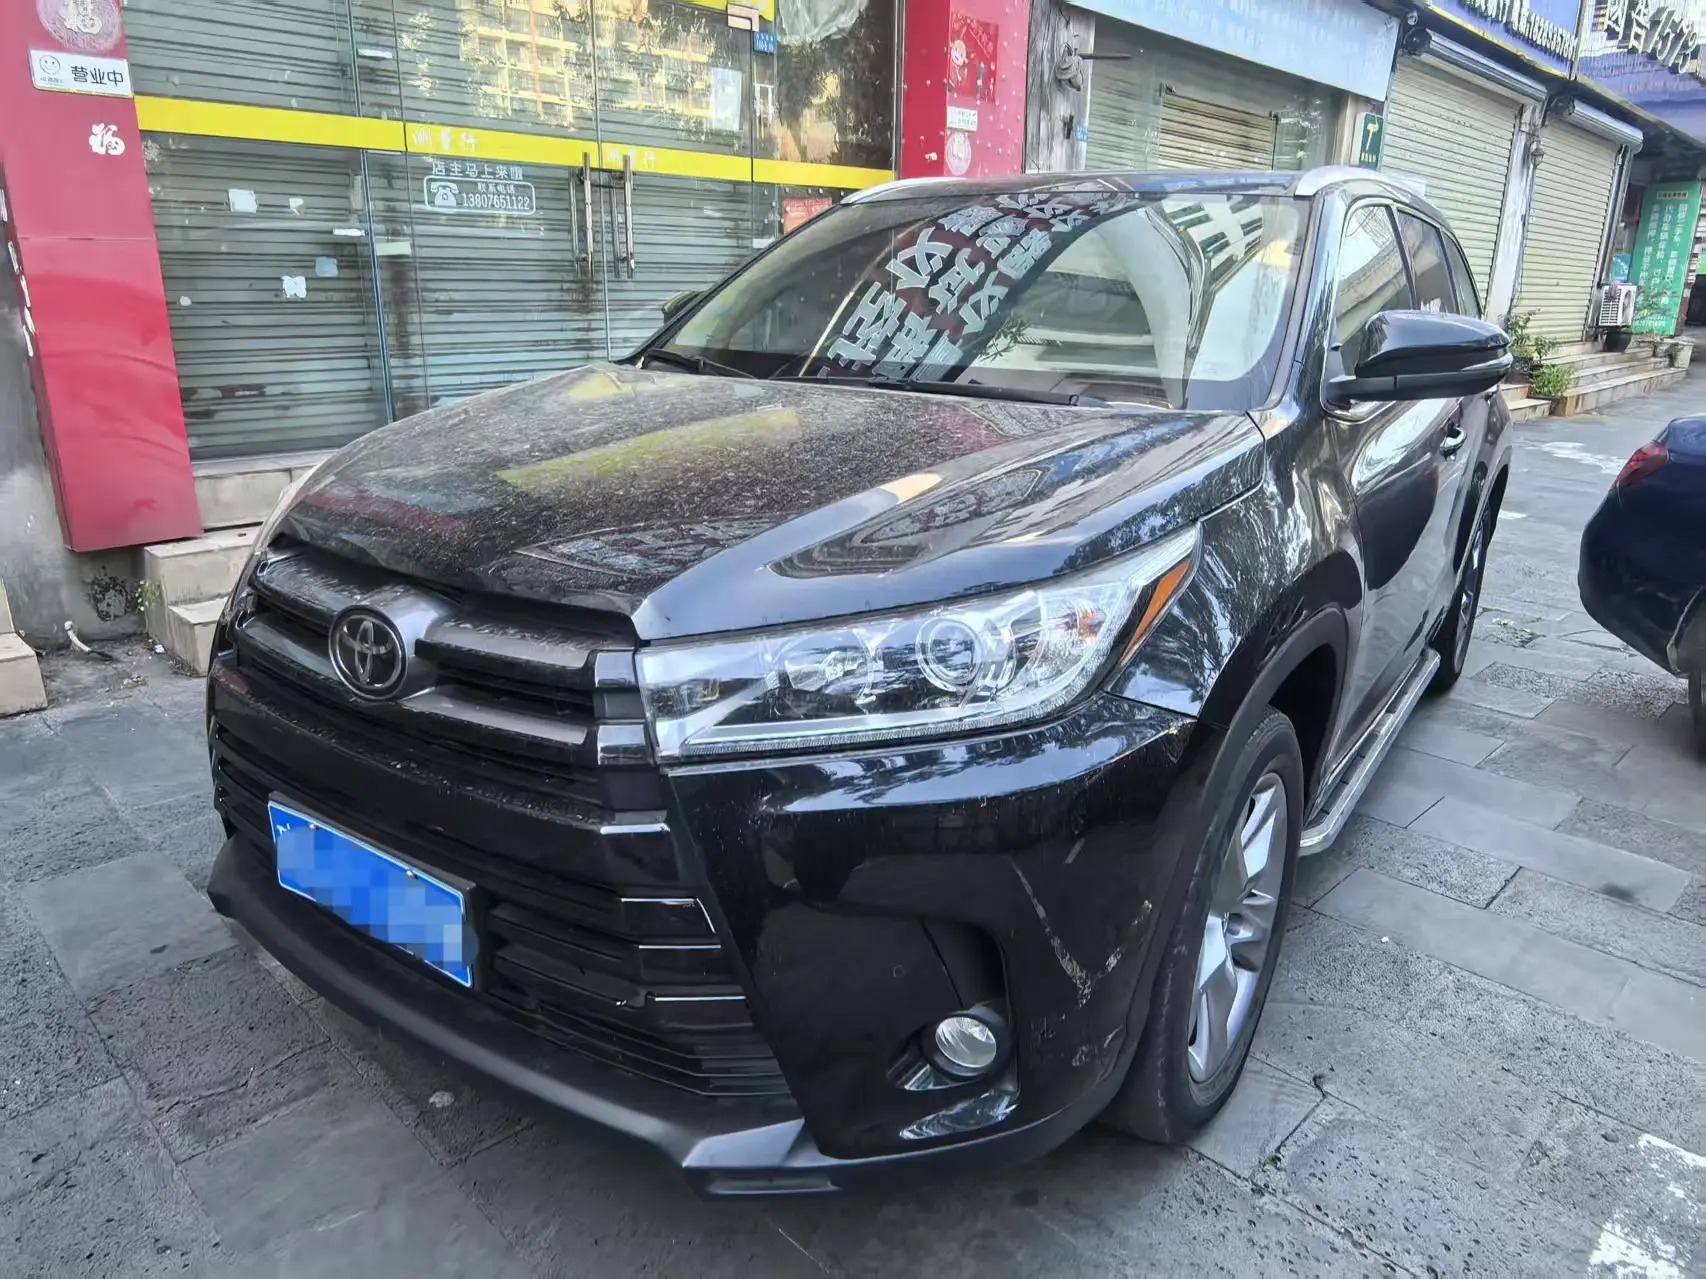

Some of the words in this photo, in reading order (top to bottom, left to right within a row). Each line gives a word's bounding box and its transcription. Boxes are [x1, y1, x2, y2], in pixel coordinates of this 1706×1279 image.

[71, 66, 124, 87] 营业中
[477, 182, 515, 195] 联系电话
